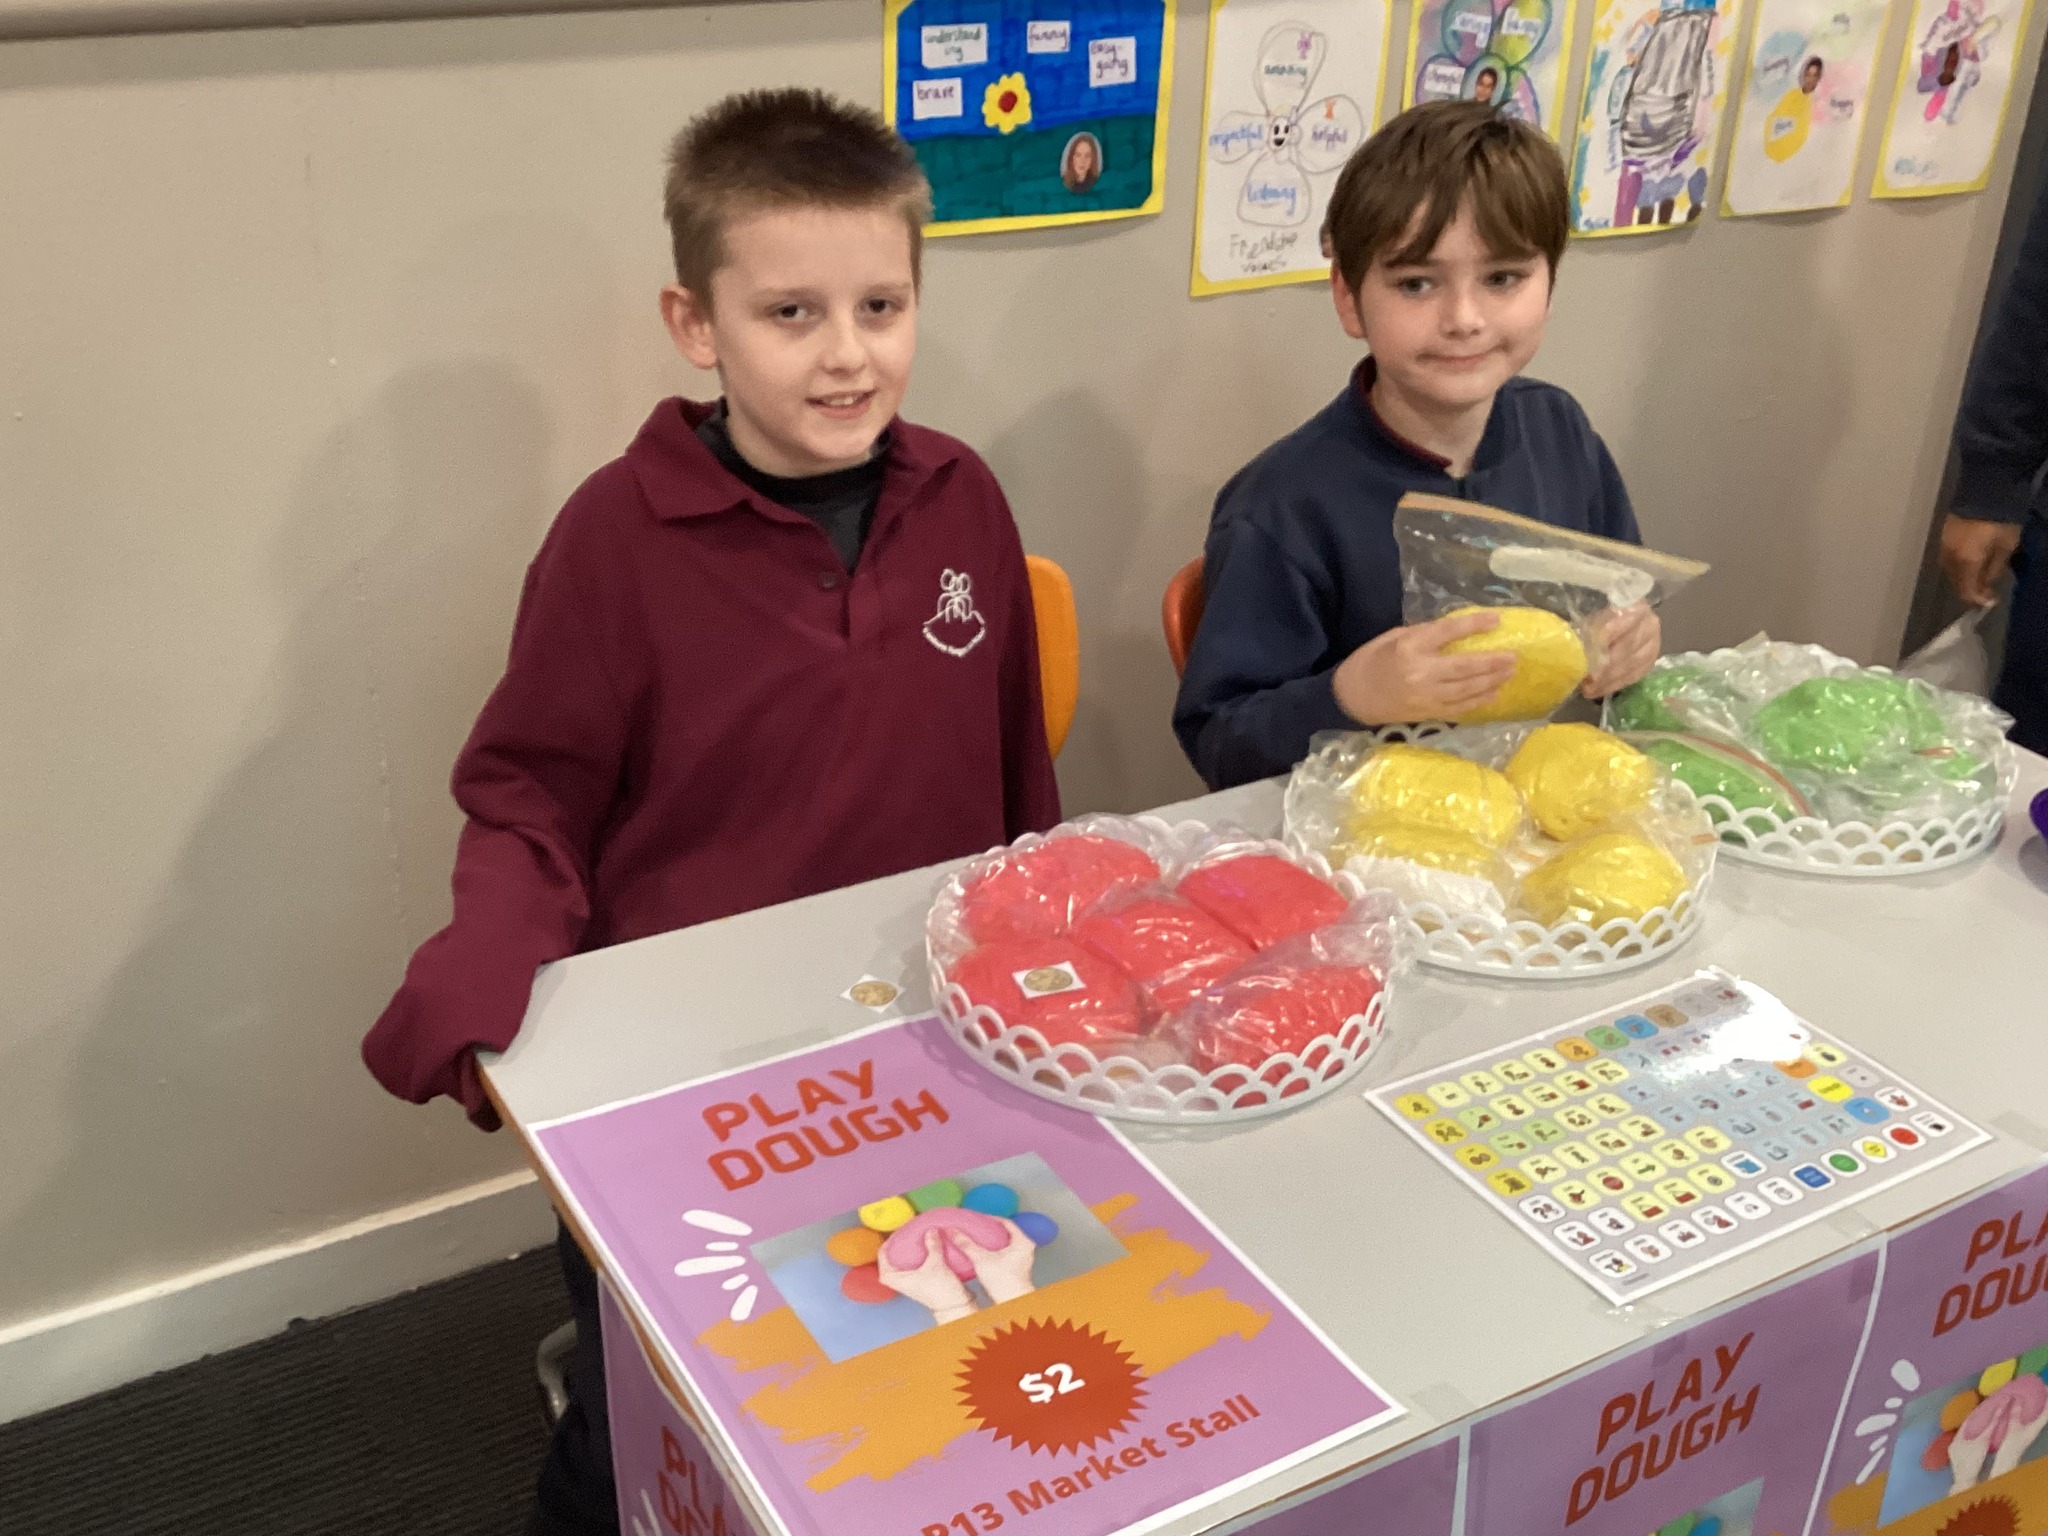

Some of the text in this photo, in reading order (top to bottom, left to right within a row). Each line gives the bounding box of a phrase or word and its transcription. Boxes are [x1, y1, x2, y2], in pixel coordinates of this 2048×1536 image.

[924, 28, 982, 44] understand
[1028, 24, 1068, 49] funny
[916, 84, 955, 100] brave
[702, 1059, 873, 1142] PLAY
[707, 1089, 949, 1191] DOUGH
[1932, 1254, 2048, 1338] DOU
[1018, 1363, 1086, 1403] $2
[1596, 1332, 1755, 1456] PLAY
[1006, 1438, 1167, 1516] Market
[1165, 1394, 1261, 1448] Stall
[1565, 1383, 1761, 1527] DOUGH
